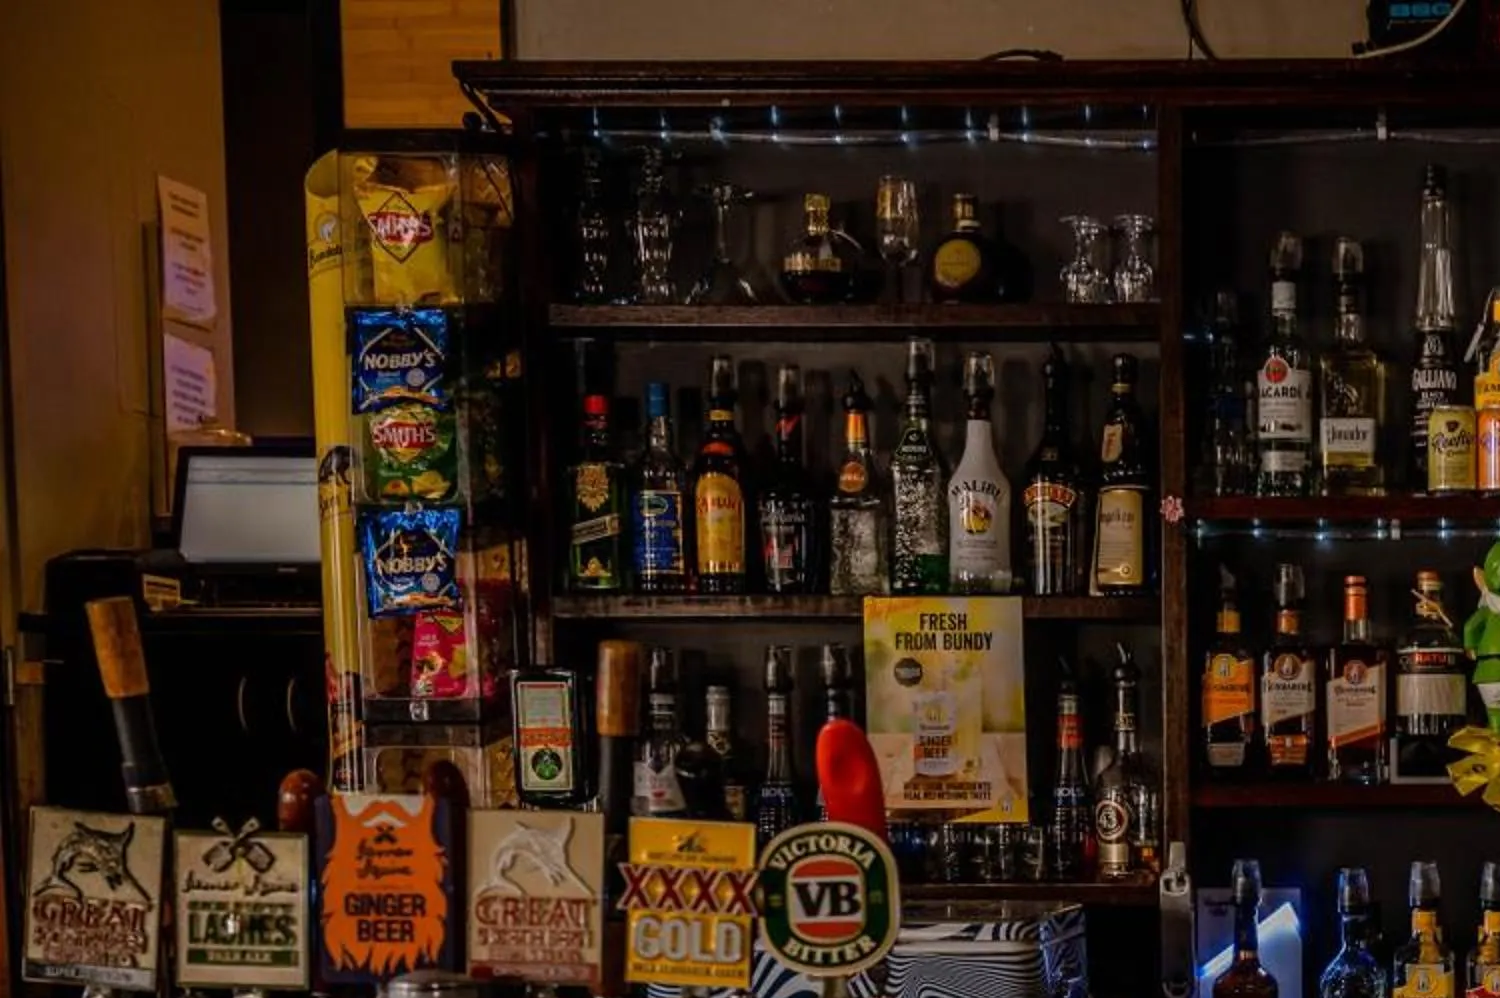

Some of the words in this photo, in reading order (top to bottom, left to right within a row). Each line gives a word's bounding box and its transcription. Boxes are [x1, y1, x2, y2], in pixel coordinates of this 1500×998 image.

[364, 350, 437, 371] NOBBY'S
[370, 421, 436, 446] SMITH'S
[376, 551, 448, 576] NOBBY'S
[919, 613, 968, 631] FRESH
[895, 632, 937, 651] FROM
[943, 632, 993, 651] BUNDY
[769, 833, 877, 872] VICTORIA
[617, 862, 760, 918] XXXX
[794, 881, 860, 918] VB
[344, 892, 427, 918] GINGER
[475, 895, 597, 928] GREAT
[188, 912, 297, 946] LASHES
[357, 920, 415, 944] BEER
[634, 915, 743, 963] GOLD
[784, 934, 878, 964] BITTER
